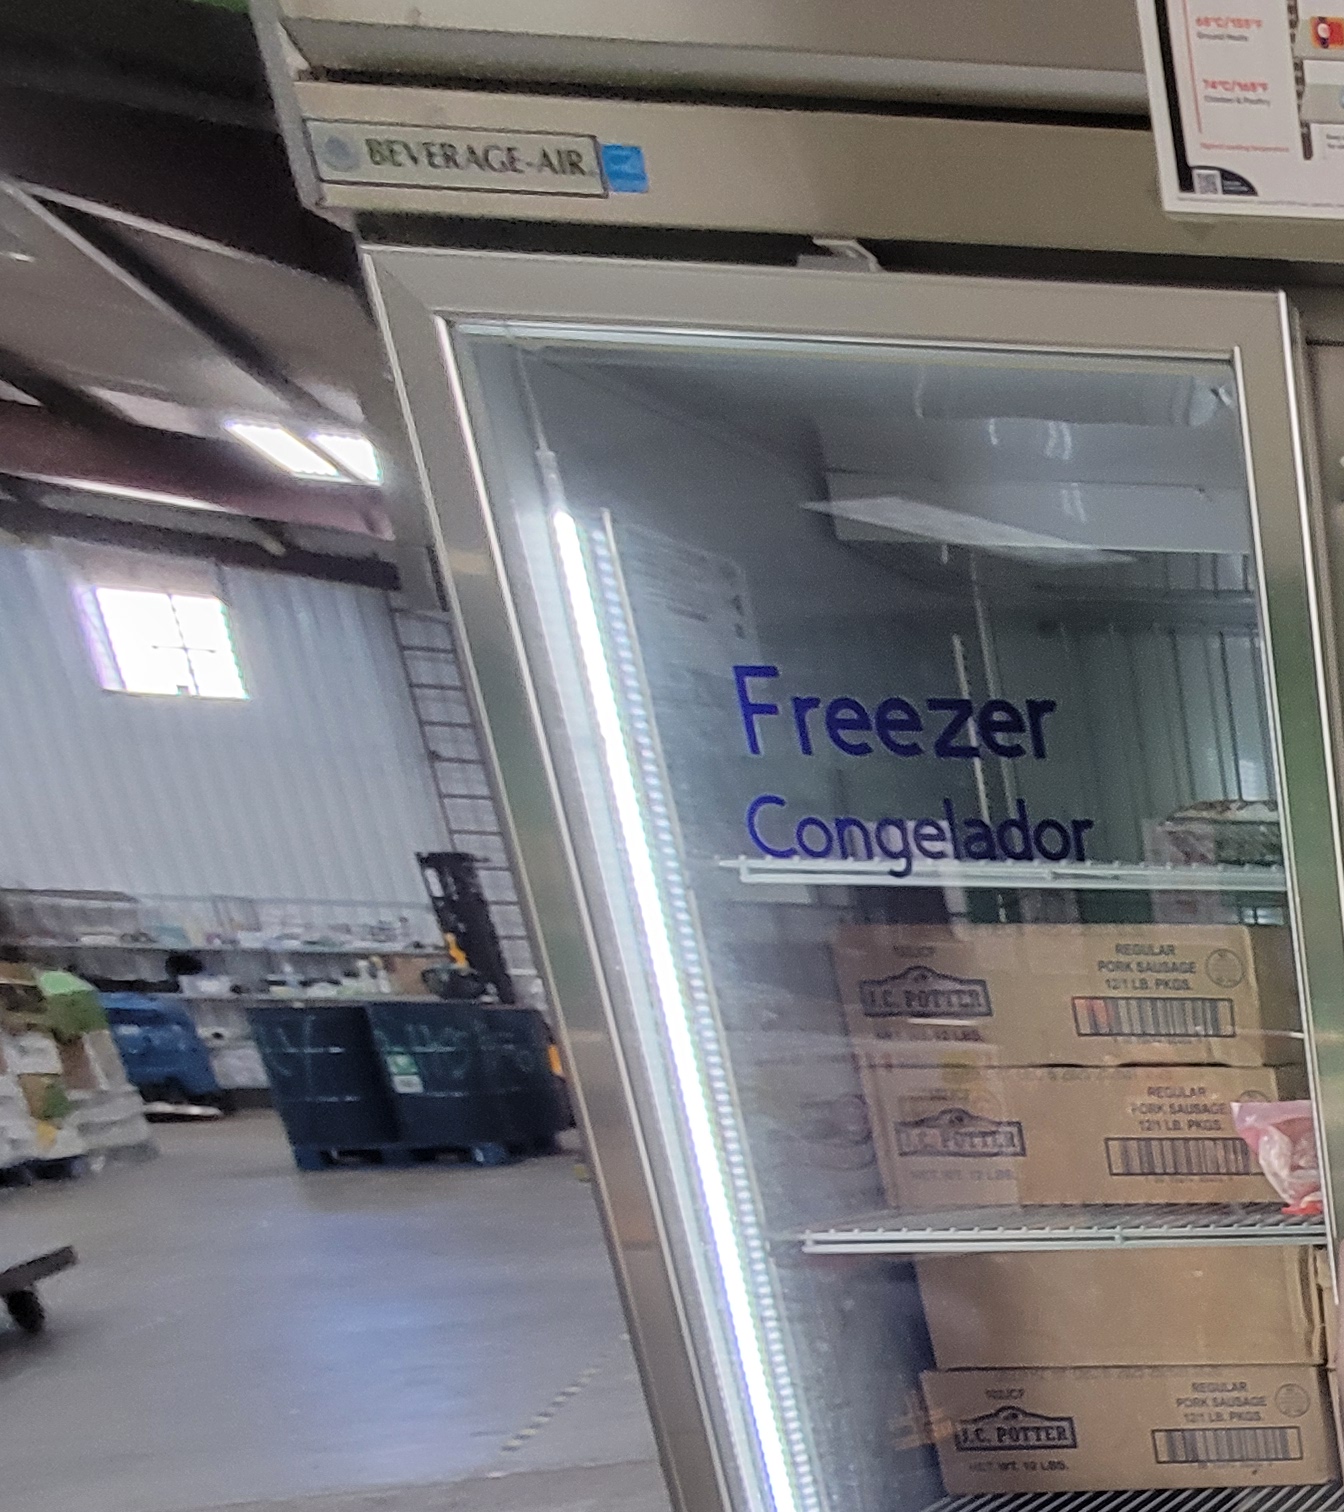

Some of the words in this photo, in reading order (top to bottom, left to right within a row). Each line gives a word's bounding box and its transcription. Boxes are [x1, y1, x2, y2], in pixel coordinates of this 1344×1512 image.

[365, 137, 587, 178] BEVERAGE-AIR
[732, 664, 1057, 759] Freezer
[746, 794, 1095, 877] Congelador
[996, 1426, 1068, 1444] POTTER
